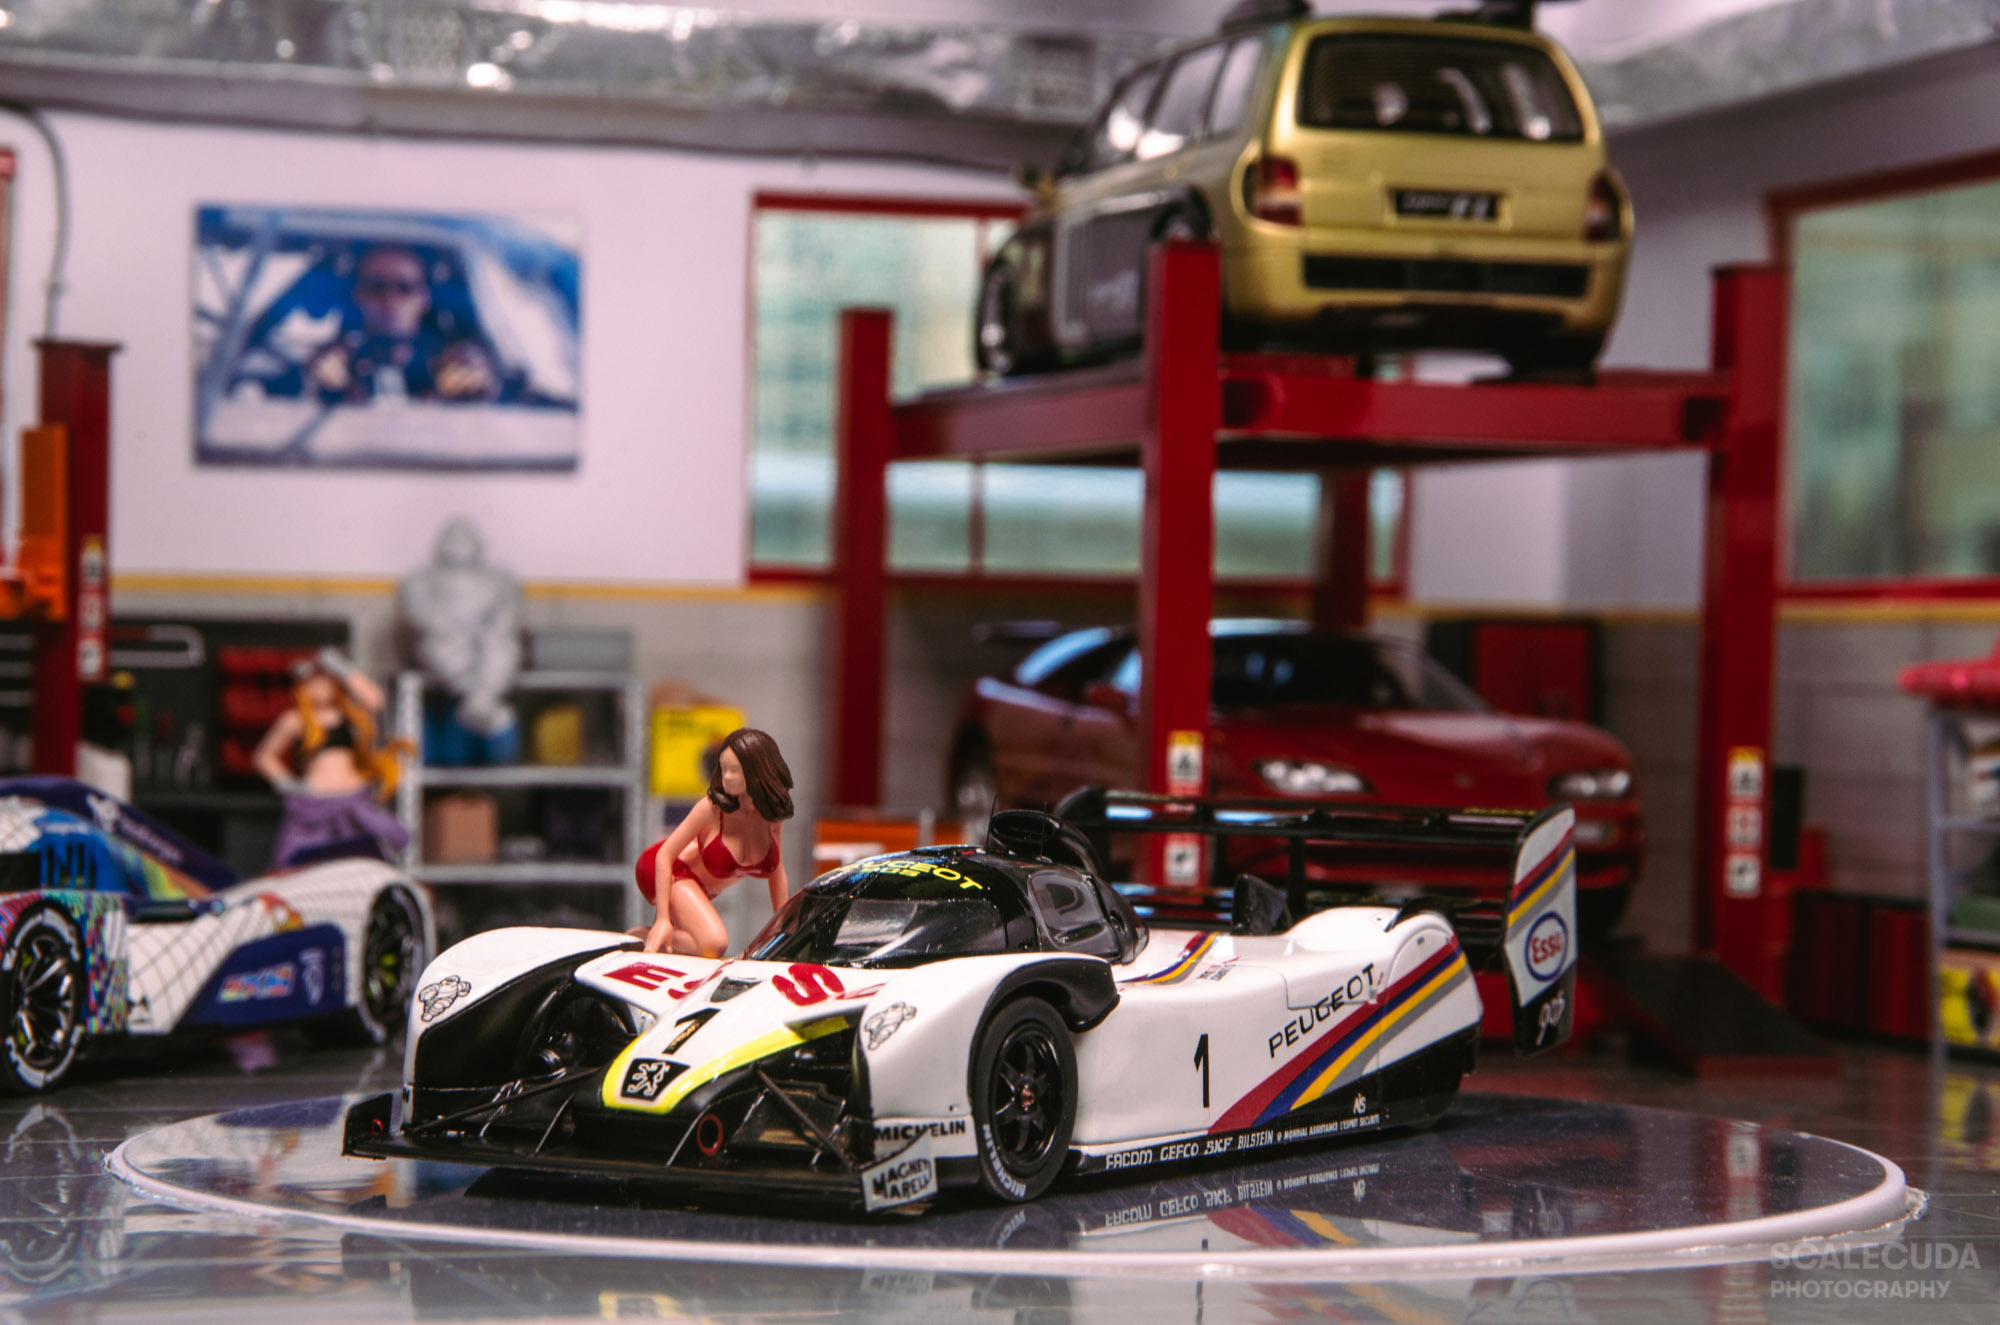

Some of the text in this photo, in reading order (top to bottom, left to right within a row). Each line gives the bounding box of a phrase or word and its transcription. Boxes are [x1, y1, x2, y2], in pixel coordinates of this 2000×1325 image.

[661, 1007, 722, 1055] 1
[1268, 962, 1374, 1059] PEUGEOT
[1194, 1033, 1209, 1109] 1
[1105, 1149, 1153, 1170] FACOM
[1160, 1143, 1199, 1162] GEFCO
[1204, 1137, 1234, 1156] SKF
[1237, 1130, 1273, 1150] BILSTEIN
